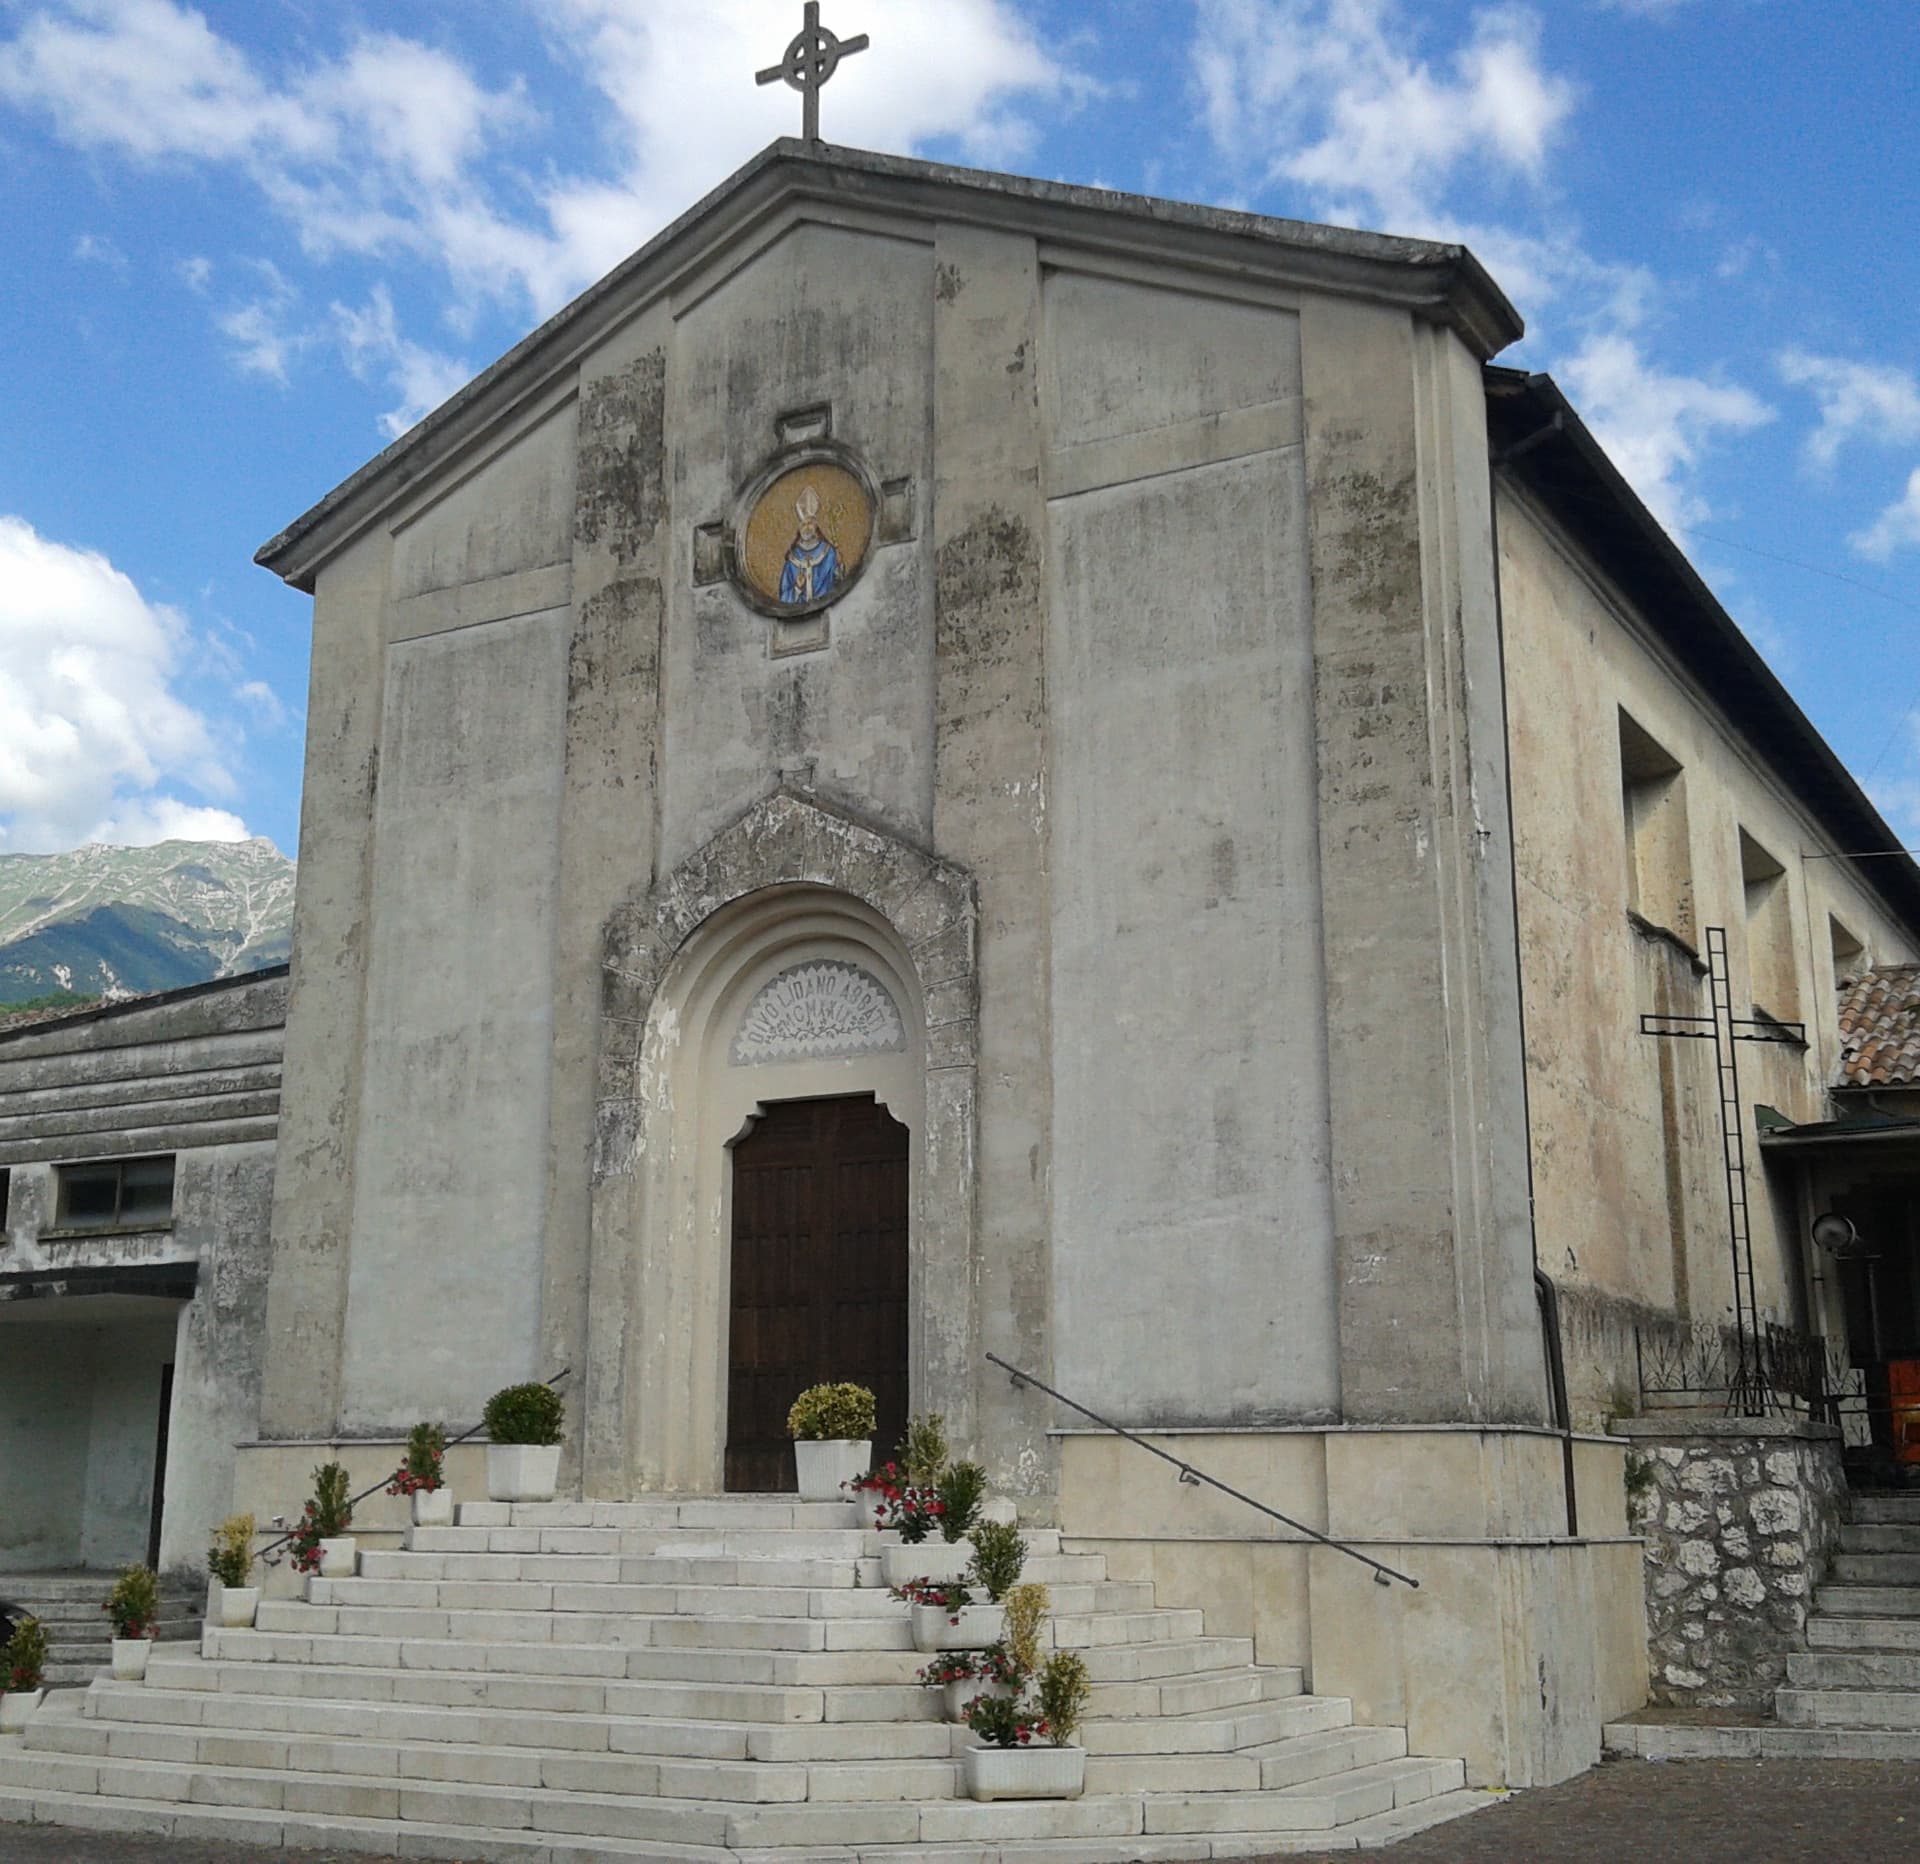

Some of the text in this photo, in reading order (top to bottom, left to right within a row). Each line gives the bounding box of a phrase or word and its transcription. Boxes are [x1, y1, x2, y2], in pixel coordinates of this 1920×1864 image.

[748, 975, 887, 1044] DIVO LIDANO ABBATI
